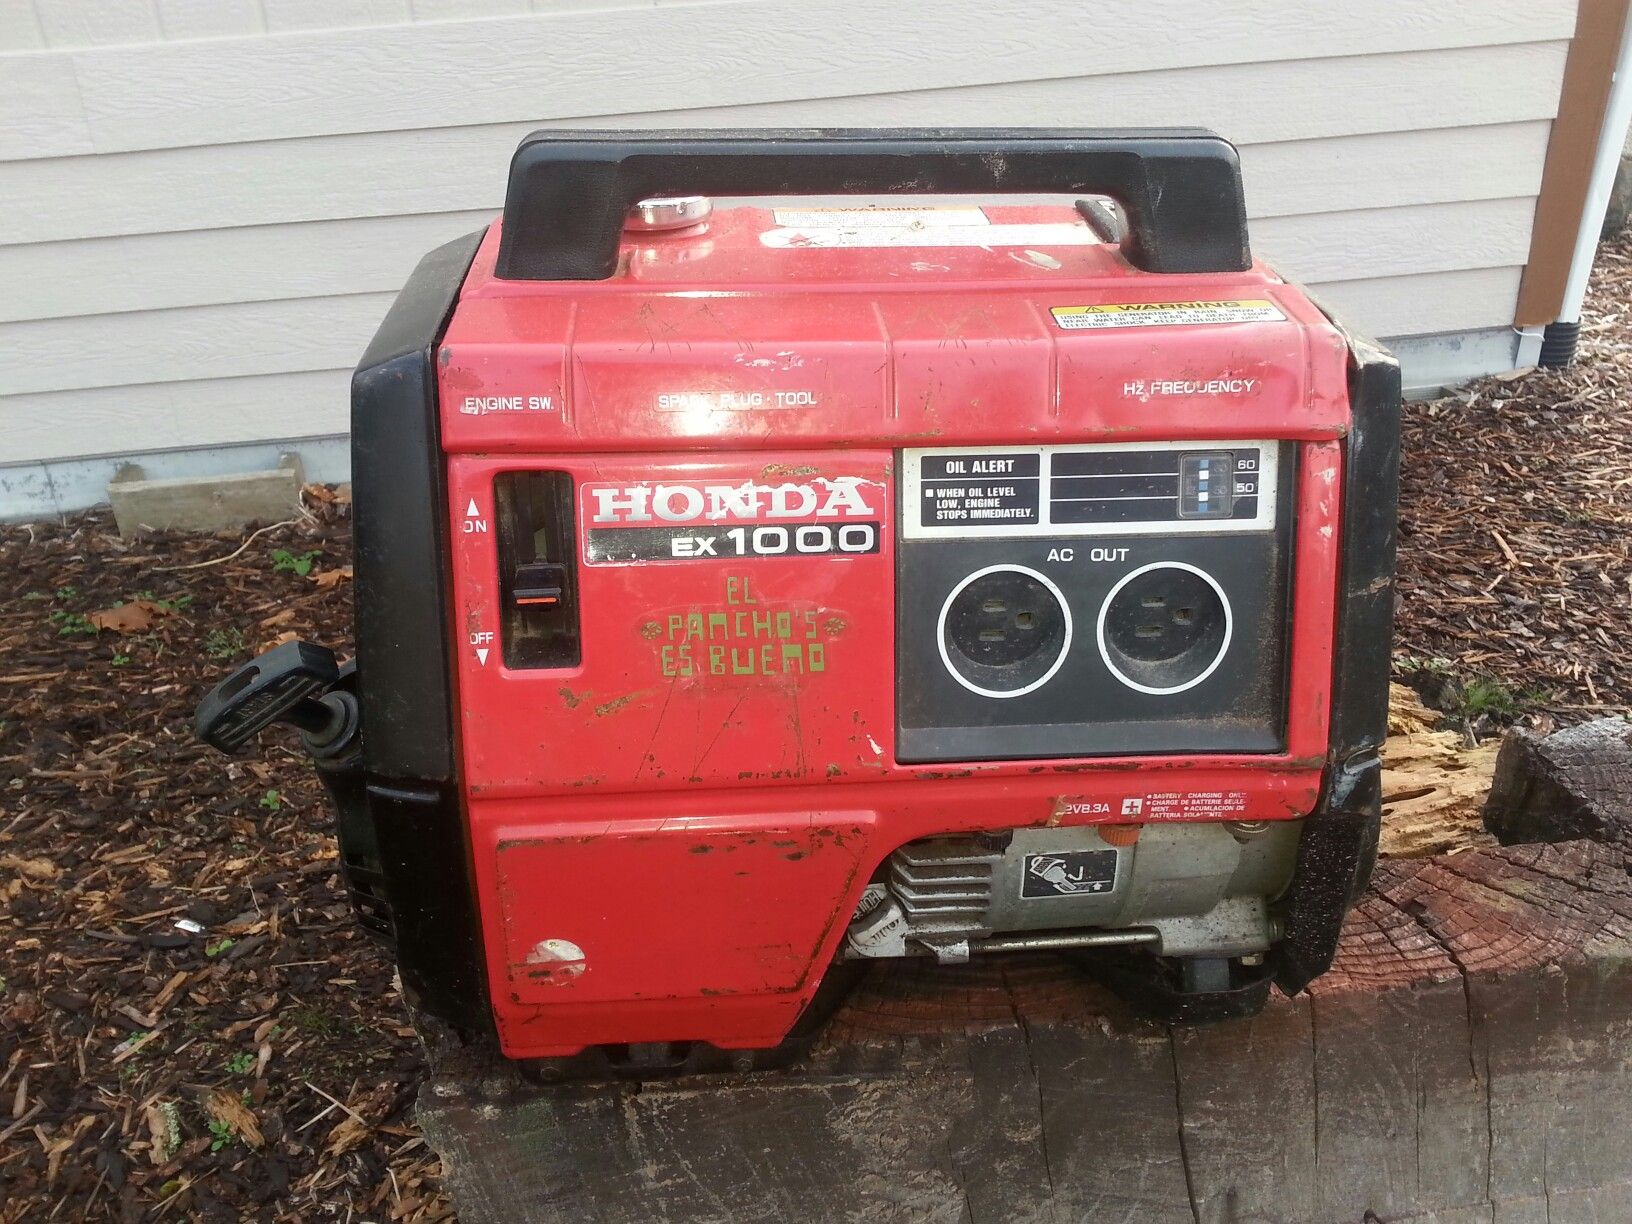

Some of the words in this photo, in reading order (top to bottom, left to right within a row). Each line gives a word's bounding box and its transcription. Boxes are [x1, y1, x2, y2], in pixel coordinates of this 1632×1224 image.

[1117, 301, 1240, 311] WARNING
[1124, 382, 1144, 395] Hz
[465, 396, 523, 410] ENGINE
[529, 396, 554, 410] SW.
[720, 392, 763, 406] PLUG
[775, 391, 818, 406] TOOL
[945, 460, 967, 474] OIL
[971, 459, 1015, 473] ALERT
[1237, 459, 1255, 470] 60
[936, 487, 965, 498] WHEN
[968, 487, 984, 497] OIL
[987, 486, 1016, 497] LEVEL
[1236, 482, 1254, 493] 50
[592, 480, 874, 523] HONDA
[936, 498, 961, 510] LOW,
[965, 497, 1000, 508] ENGINE
[936, 509, 967, 520] STOPS
[970, 507, 1035, 519] IMMEDIATELY.
[463, 519, 487, 533] ON
[671, 536, 717, 557] EX
[726, 524, 875, 556] 1000
[1047, 548, 1074, 562] AC
[1090, 548, 1130, 562] OUT
[726, 576, 757, 605] EL
[469, 631, 494, 645] OFF
[660, 644, 694, 677] ES
